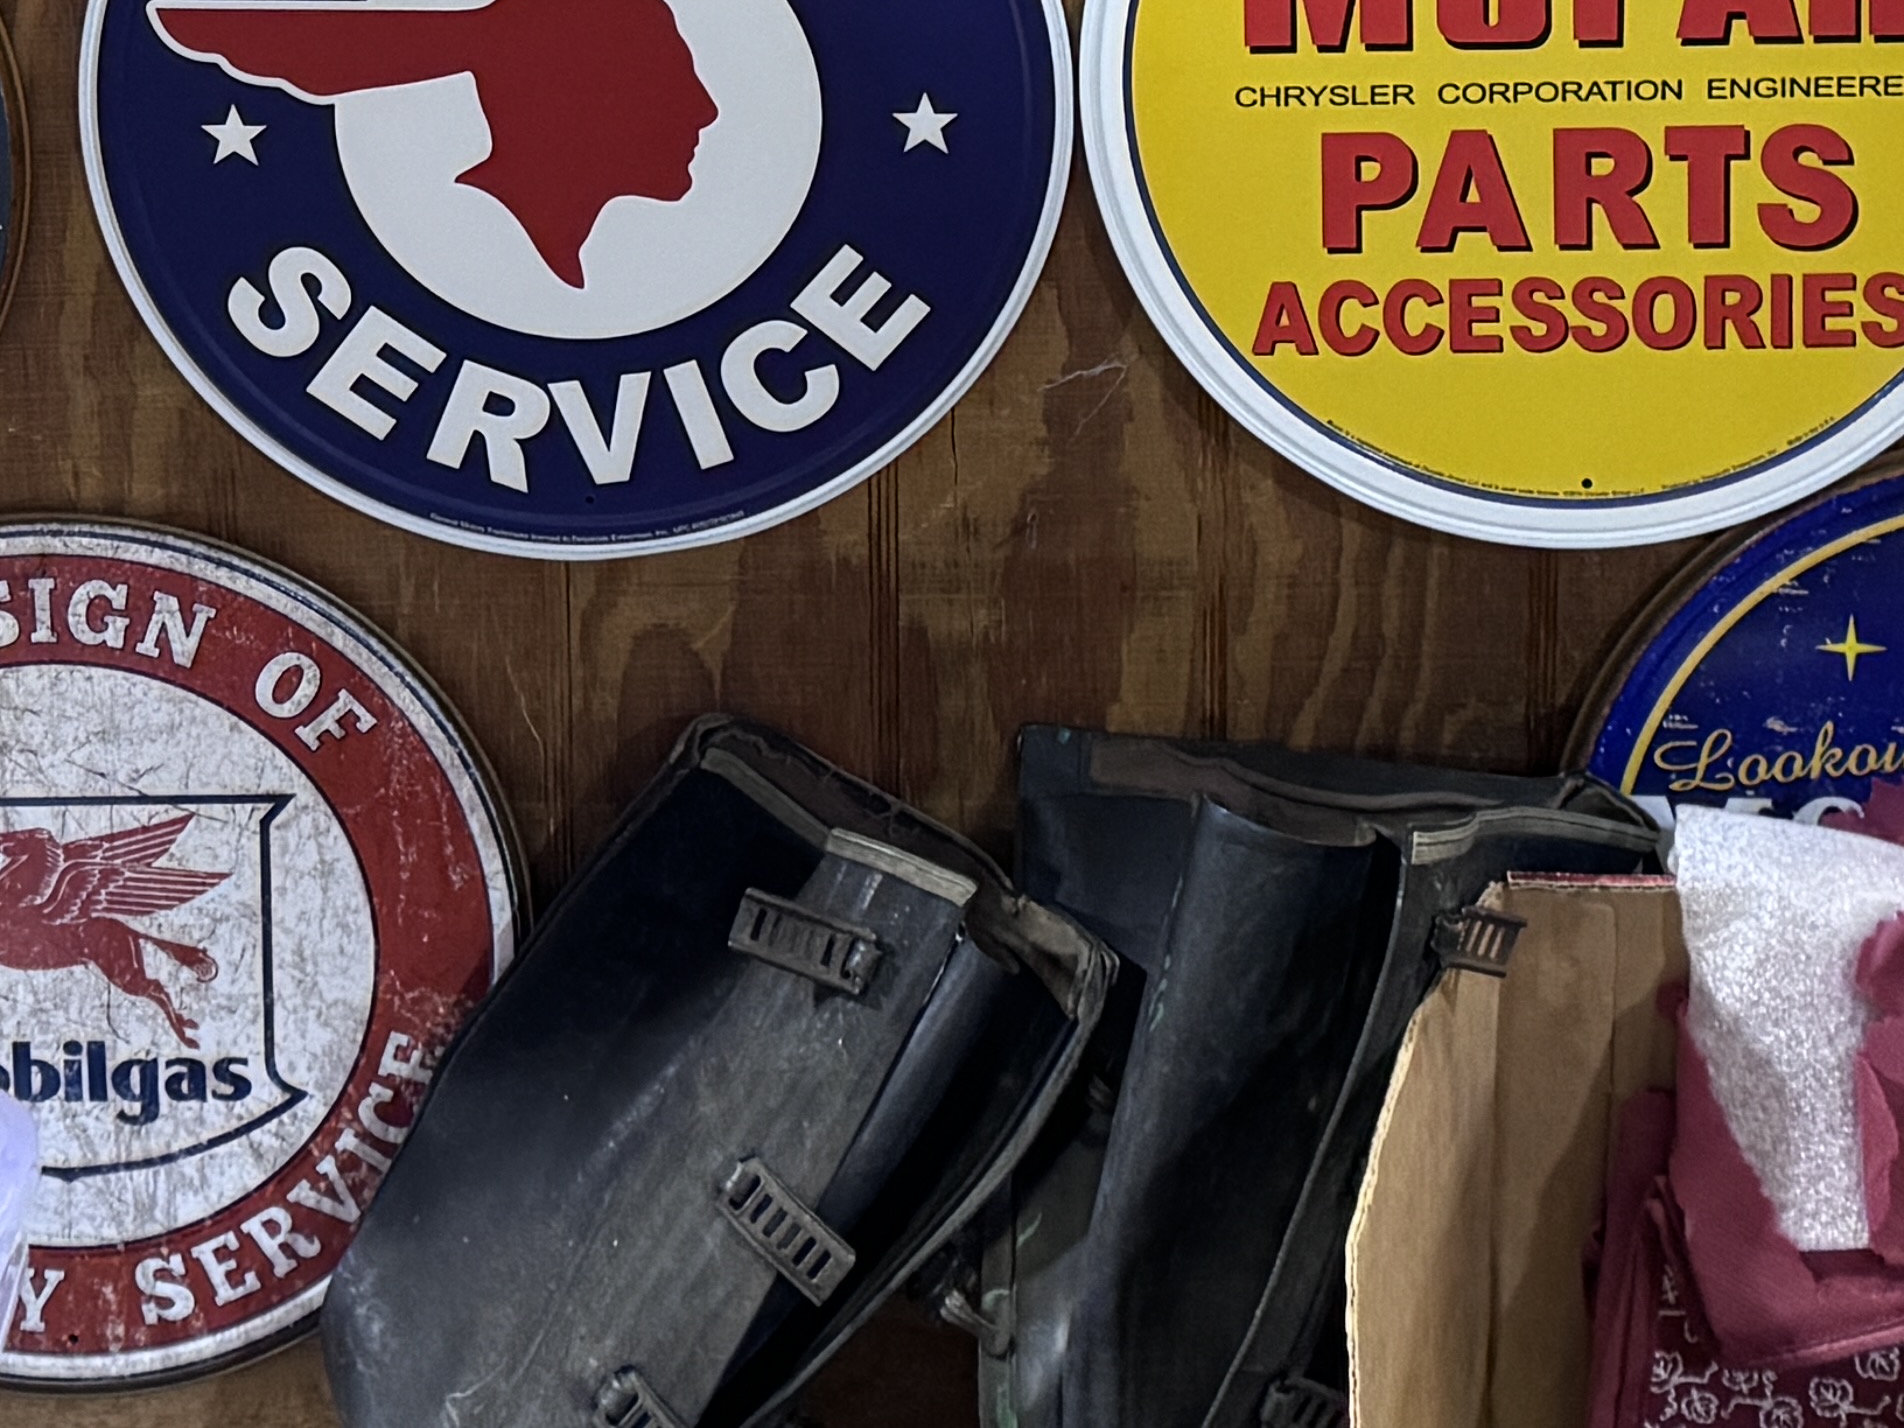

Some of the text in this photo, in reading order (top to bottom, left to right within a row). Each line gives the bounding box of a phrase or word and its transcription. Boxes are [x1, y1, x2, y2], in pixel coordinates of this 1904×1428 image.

[1235, 81, 1415, 109] CHRYSLER
[1437, 77, 1683, 107] CORPORATION
[1318, 122, 1861, 255] PARTS
[227, 243, 933, 494] SERVICE
[252, 649, 378, 753] OF
[133, 1029, 447, 1327] SERVICE
